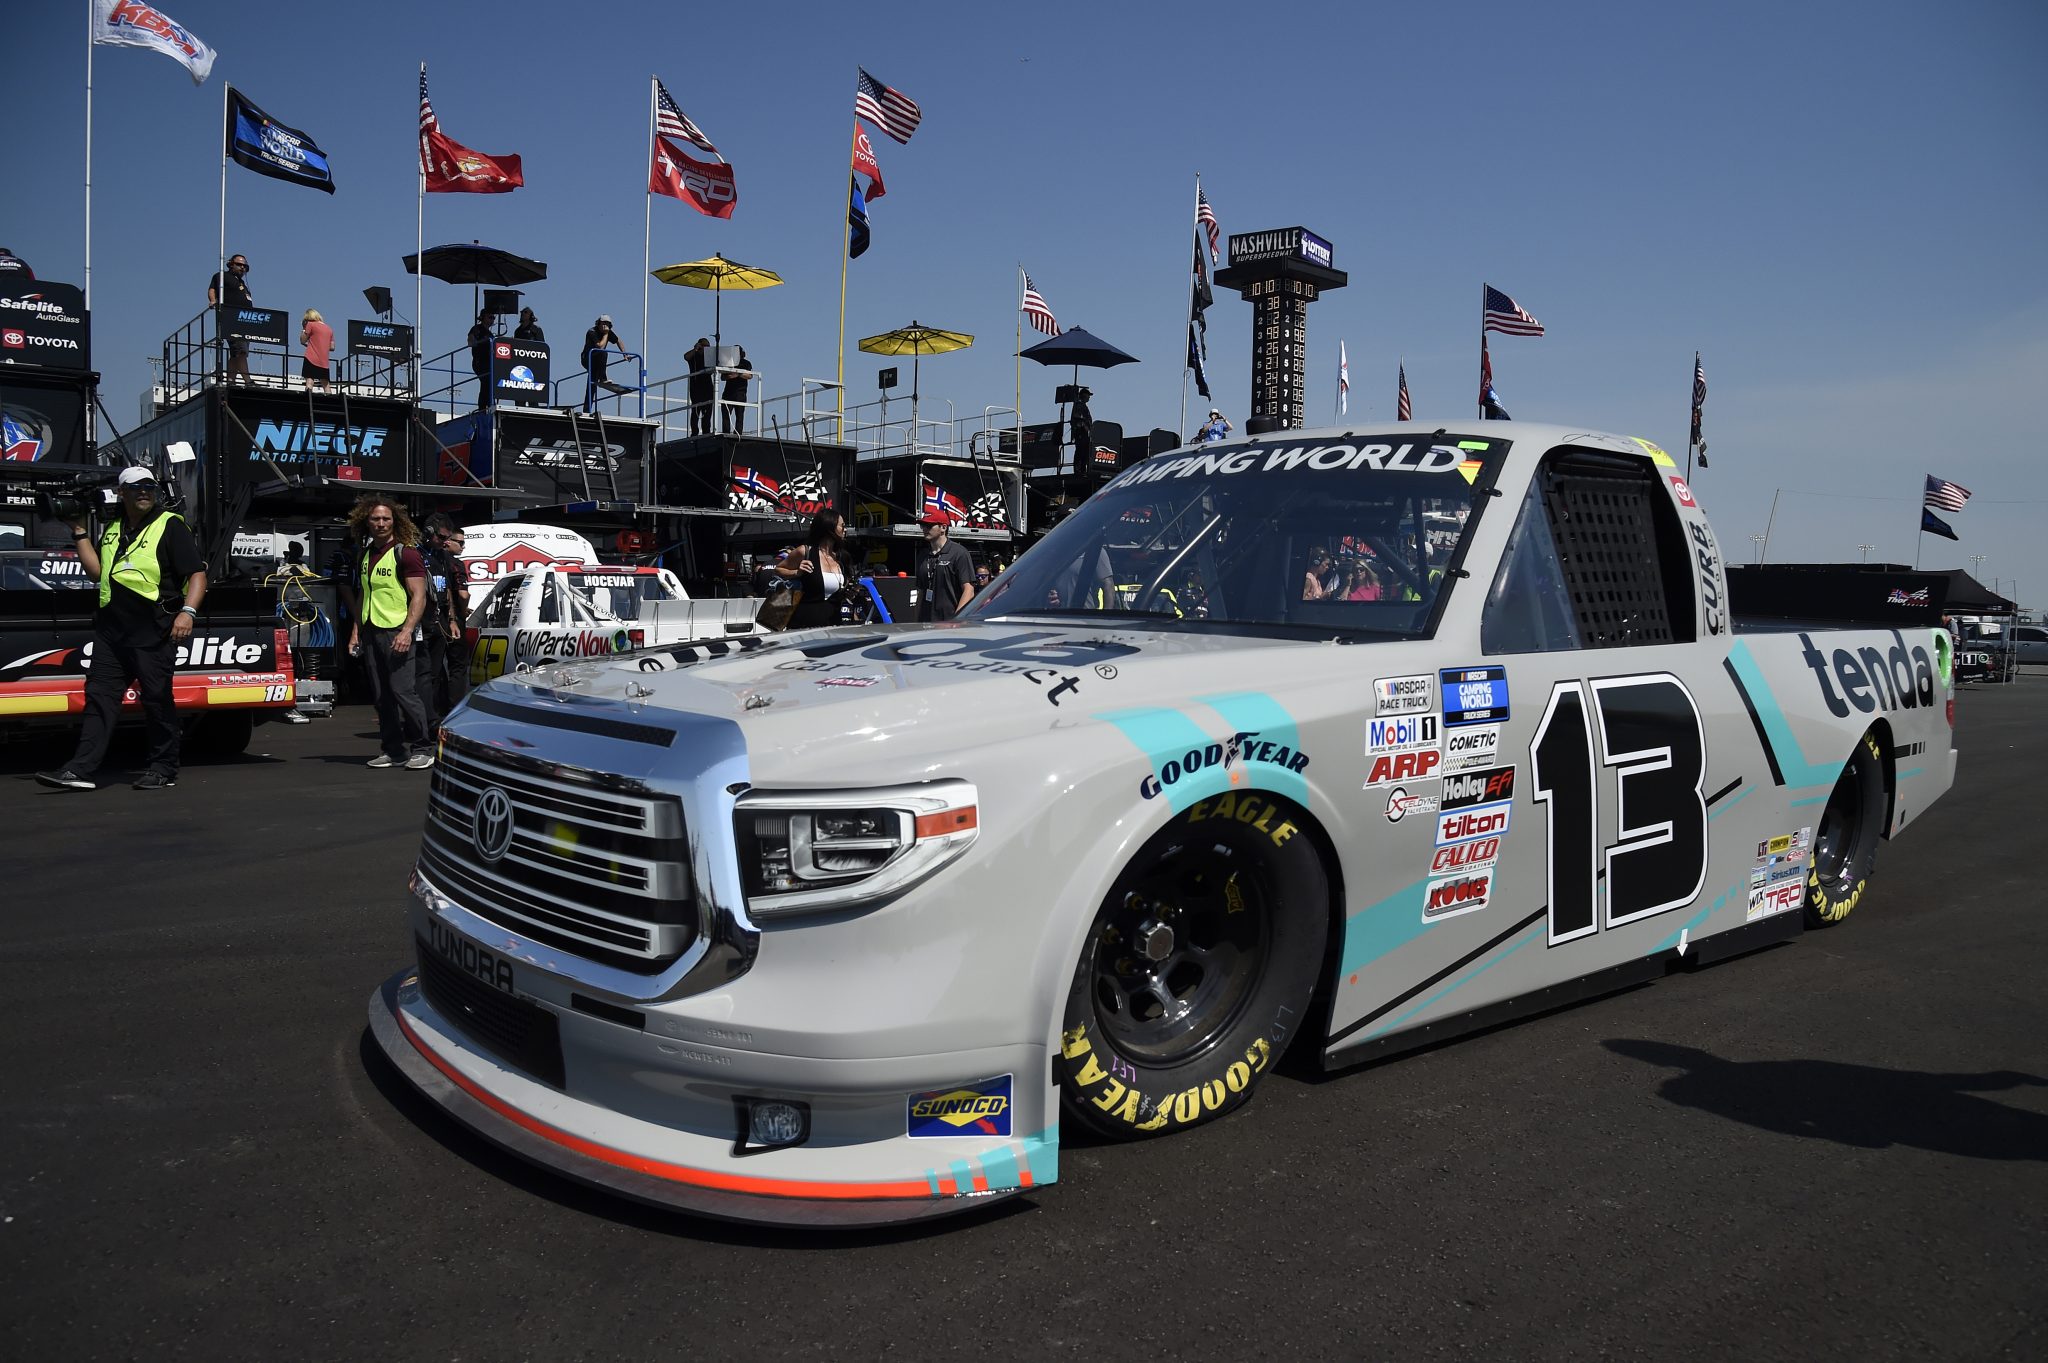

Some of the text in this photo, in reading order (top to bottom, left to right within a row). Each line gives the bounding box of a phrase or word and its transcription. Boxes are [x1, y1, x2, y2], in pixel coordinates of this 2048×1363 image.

[107, 0, 199, 59] KBM
[278, 157, 301, 171] SERIES
[1232, 229, 1300, 256] NASHVILLE
[1308, 240, 1331, 261] LOTTERY
[1235, 249, 1294, 262] SUPERSPEEDWAY
[0, 298, 63, 314] Safelite
[36, 312, 80, 324] AutoGlass
[238, 310, 272, 322] NIECE
[245, 334, 281, 343] CHEVROLET
[363, 325, 395, 337] NIECE
[27, 335, 79, 350] TOYOTA
[368, 344, 402, 352] CHEVROLET
[513, 348, 548, 360] TOYOTA
[502, 379, 536, 391] HALMAR
[252, 418, 388, 457] NIECE
[1094, 451, 1117, 461] GMS
[1108, 443, 1468, 490] AMPING WORLD
[232, 546, 270, 555] NIECE
[40, 560, 87, 575] SMIT
[376, 567, 392, 577] NBC
[583, 576, 635, 587] HOCEVAR
[1688, 520, 1720, 636] CURB
[208, 673, 287, 685] TUNDRA
[1798, 630, 1935, 719] tenda
[264, 685, 288, 702] 18
[1393, 680, 1426, 695] NASCAR
[1459, 682, 1492, 696] CAMPING
[1380, 696, 1428, 710] RACE TRUCK
[1460, 694, 1493, 709] WORLD
[1370, 717, 1417, 748] Mobil
[1449, 732, 1496, 751] COMETIC
[1366, 750, 1440, 784] ARP
[1442, 774, 1487, 802] Holley
[1529, 671, 1708, 949] 13
[1188, 791, 1298, 848] EAGLE
[1442, 812, 1506, 840] tilton
[1431, 837, 1500, 872] CALICO
[1429, 875, 1489, 909] KOOKS
[1749, 888, 1765, 911] WIX
[1765, 883, 1802, 912] TRD
[428, 916, 514, 994] TUNDRA
[915, 1098, 1003, 1115] SUNOCO
